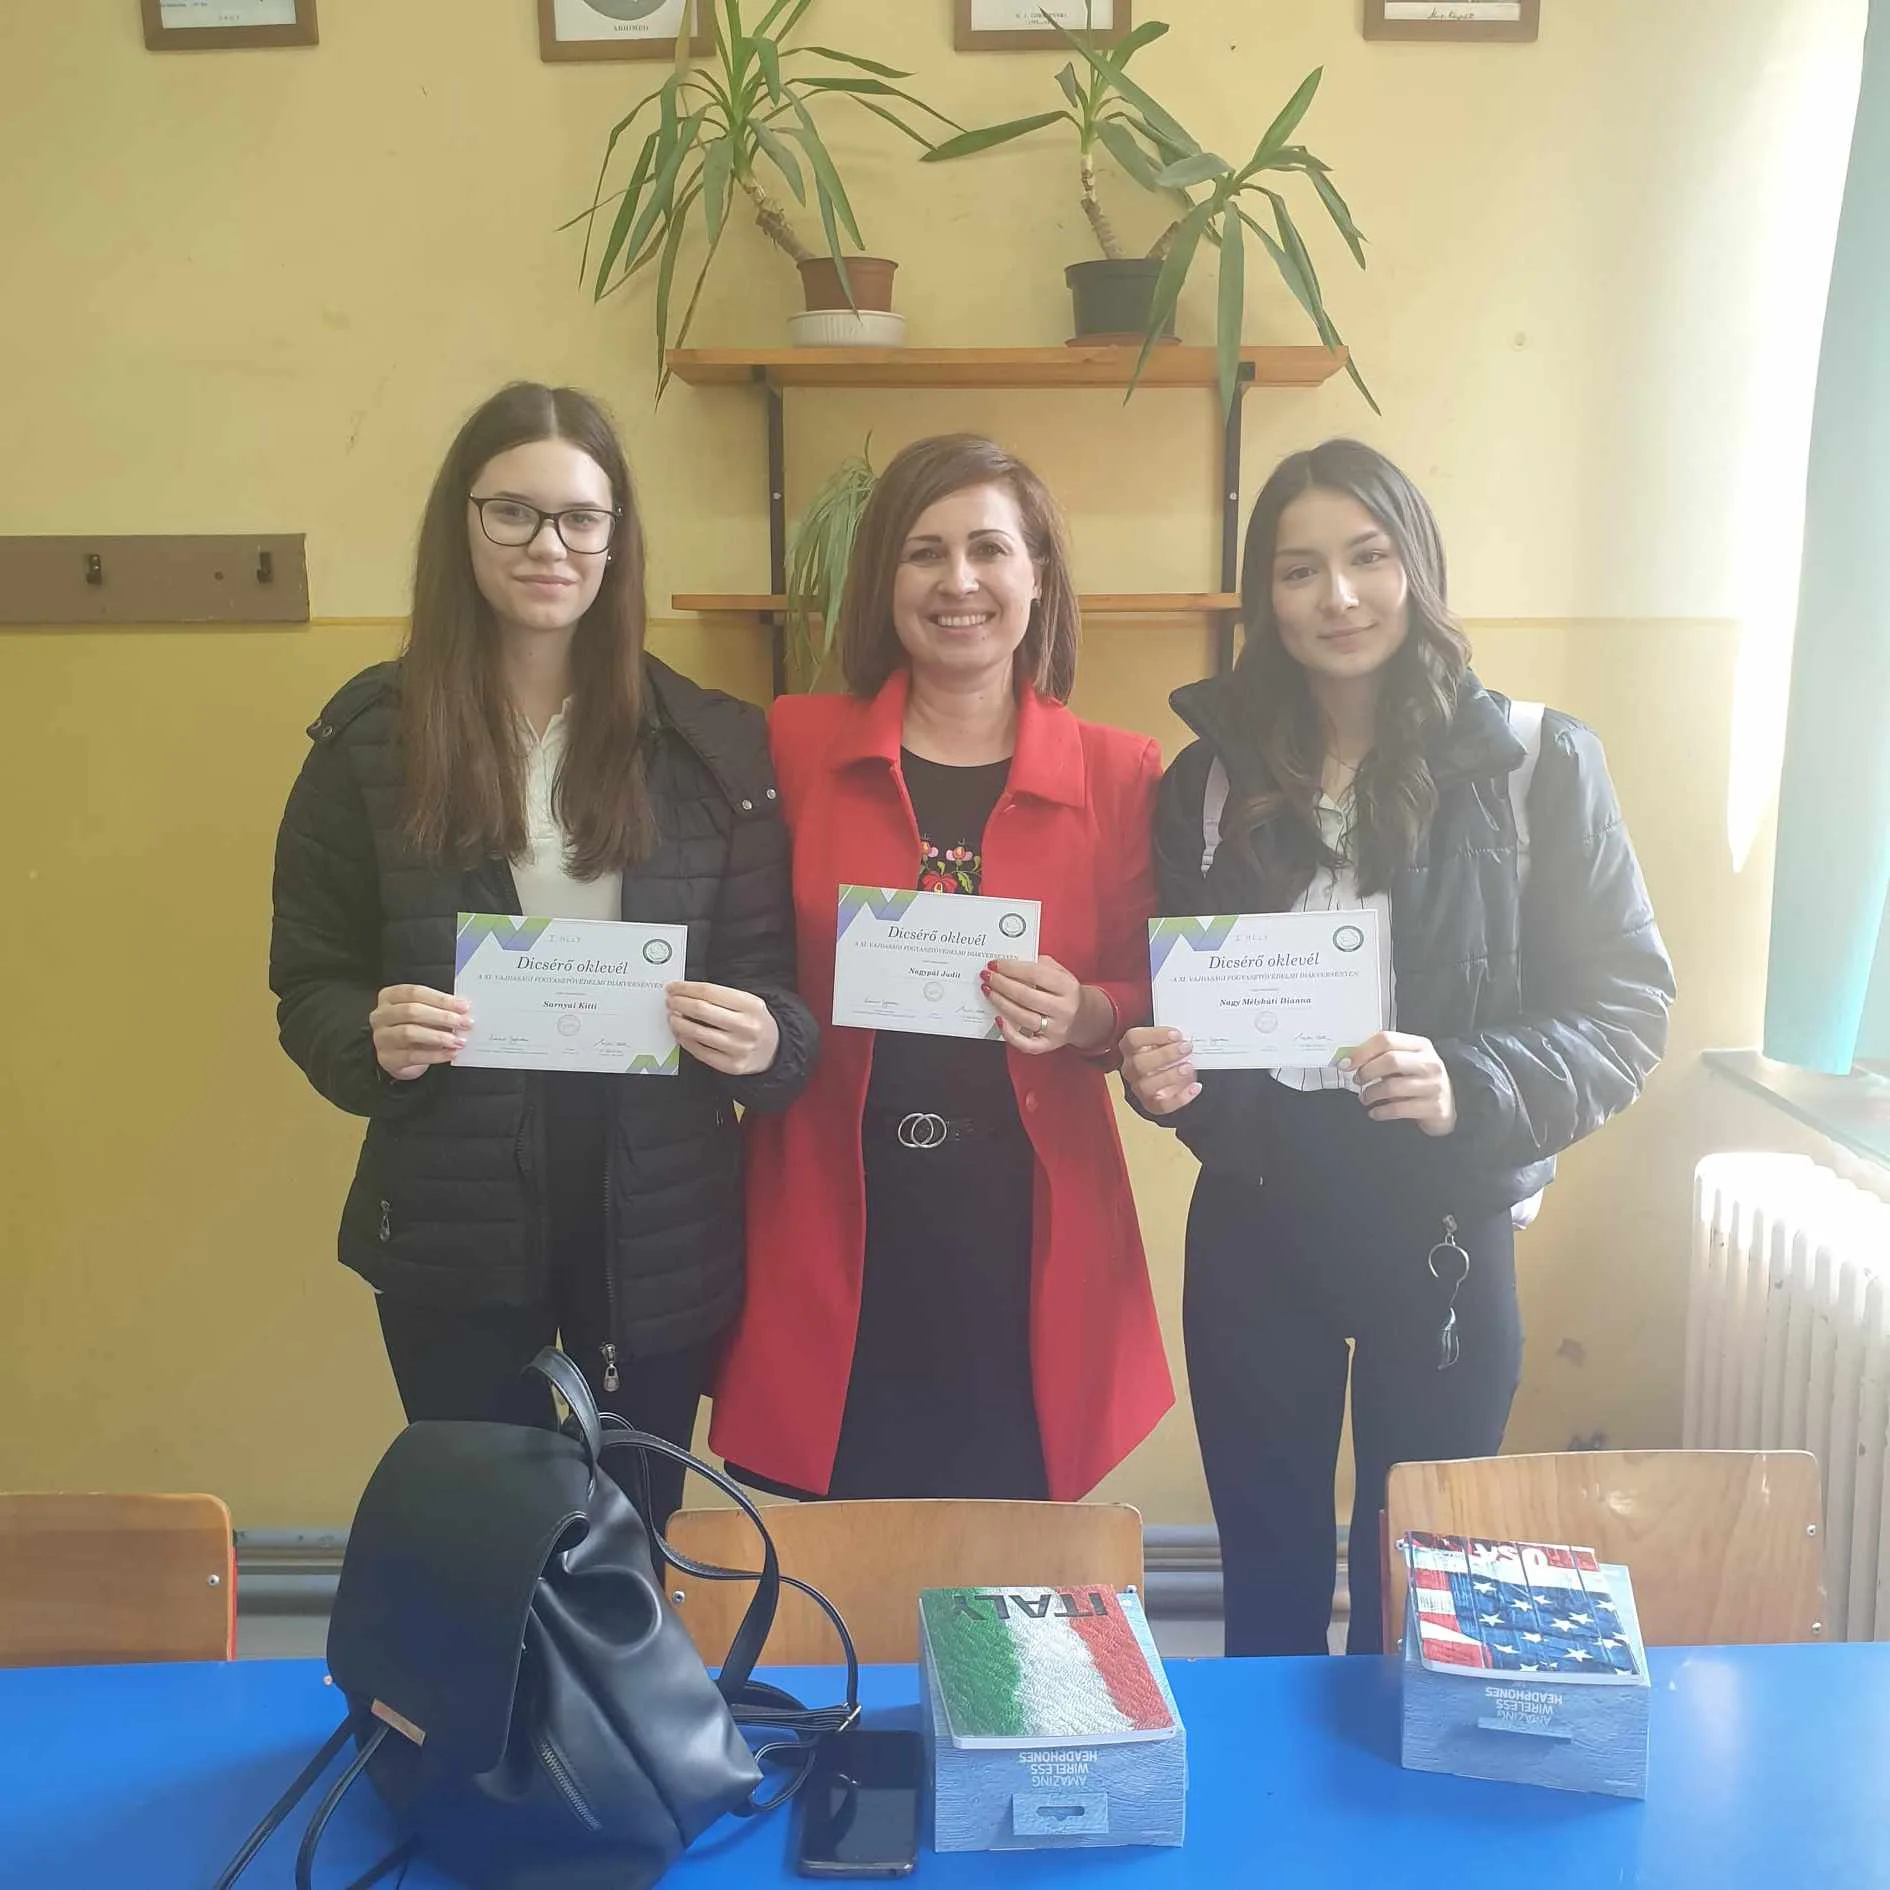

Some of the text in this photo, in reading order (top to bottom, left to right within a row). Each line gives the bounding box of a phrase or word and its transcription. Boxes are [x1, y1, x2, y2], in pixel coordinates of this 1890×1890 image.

[887, 925, 987, 946] Dicsérő oklevél
[517, 956, 628, 975] Dicsérő oklevél
[1208, 952, 1320, 969] Dicsérő oklevél
[940, 970, 961, 979] Judit
[1220, 999, 1240, 1007] Nagy
[953, 1592, 1109, 1621] ITALY
[1485, 1686, 1563, 1705] HEADPHONES
[1495, 1698, 1553, 1714] WIRELESS
[1496, 1709, 1552, 1727] AMAZING
[1018, 1750, 1098, 1763] HEADPHONES
[1030, 1763, 1089, 1775] WIRELESS
[1031, 1775, 1087, 1788] AMAZING
